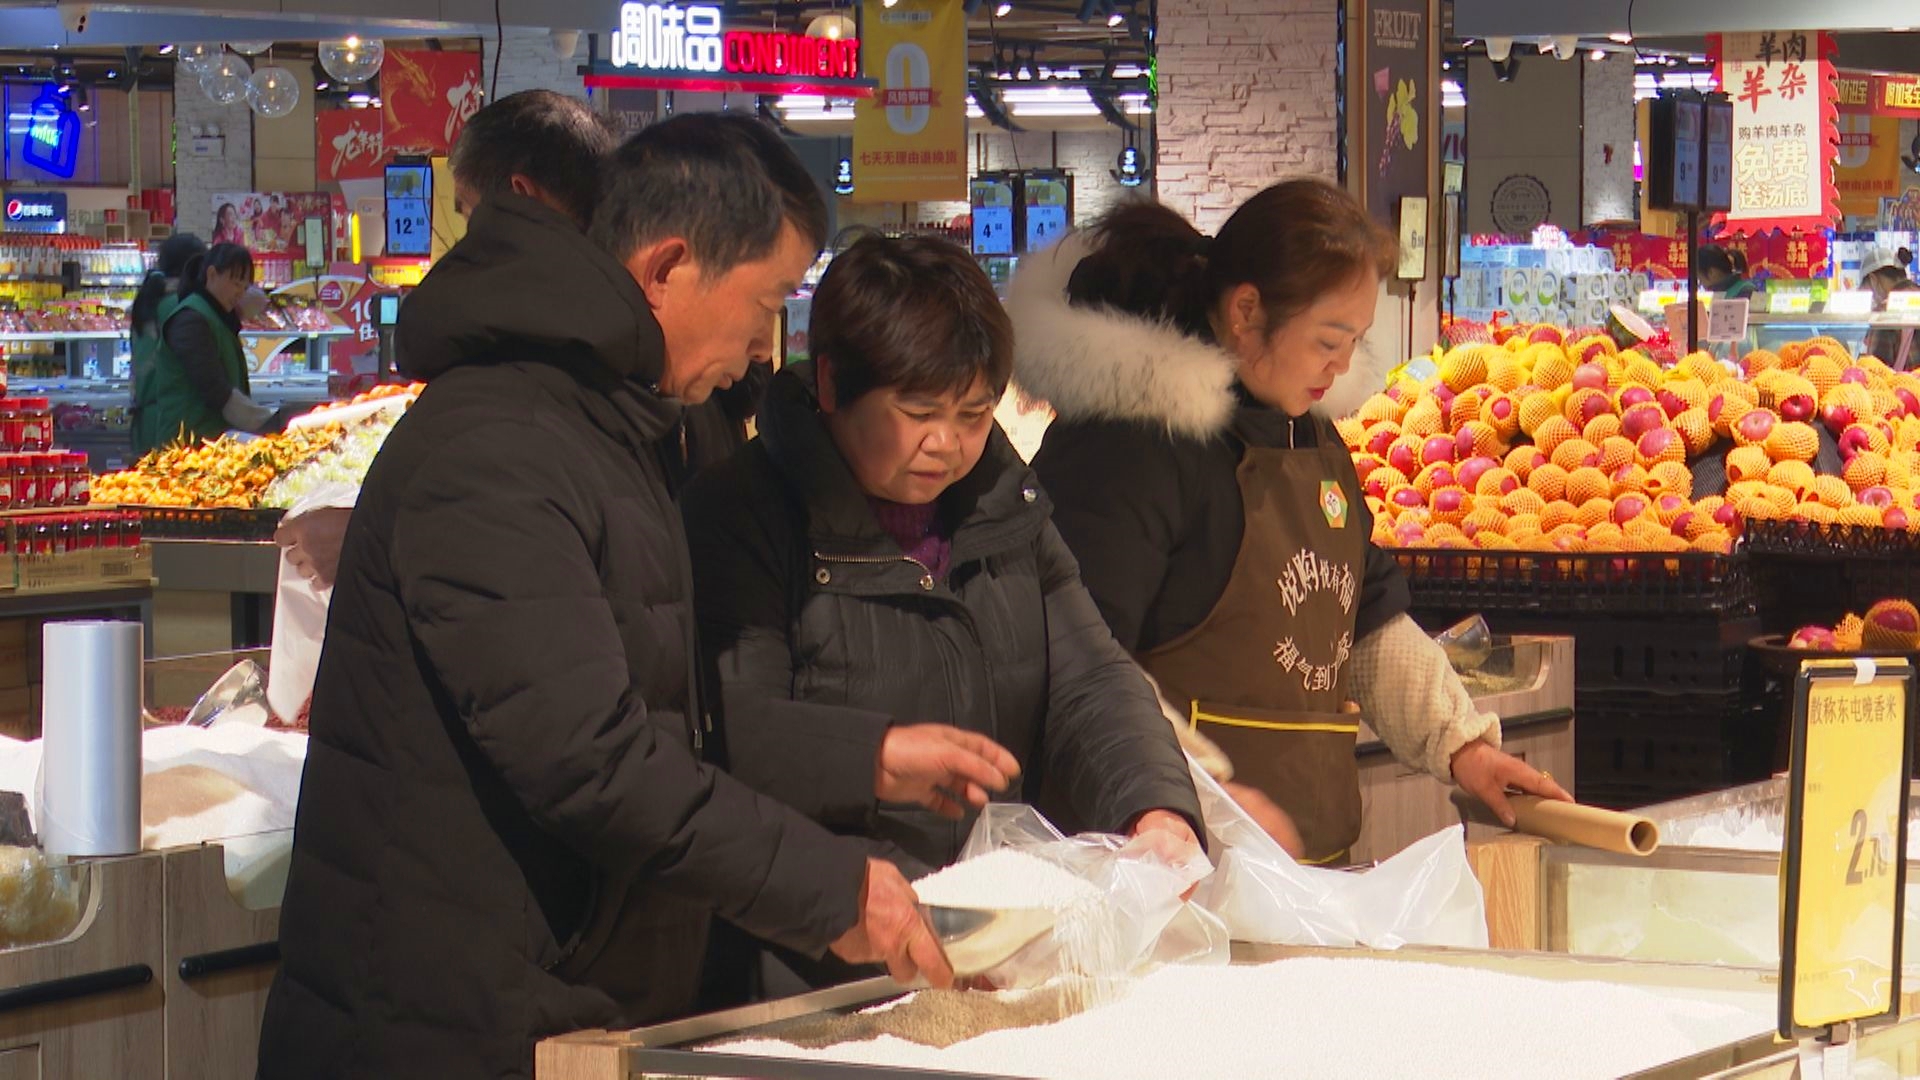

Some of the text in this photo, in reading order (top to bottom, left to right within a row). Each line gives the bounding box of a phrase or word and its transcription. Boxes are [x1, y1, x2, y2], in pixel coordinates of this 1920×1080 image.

[611, 2, 860, 78] 调味品 CONDIMENT
[1373, 9, 1421, 40] FRUIT
[1756, 31, 1807, 67] 羊肉
[1738, 63, 1807, 114] 羊杂
[1738, 123, 1806, 140] 购羊肉羊杂
[1735, 140, 1808, 184] 免费
[1738, 181, 1808, 210] 送汤底
[395, 218, 412, 235] 12
[983, 223, 991, 238] 4
